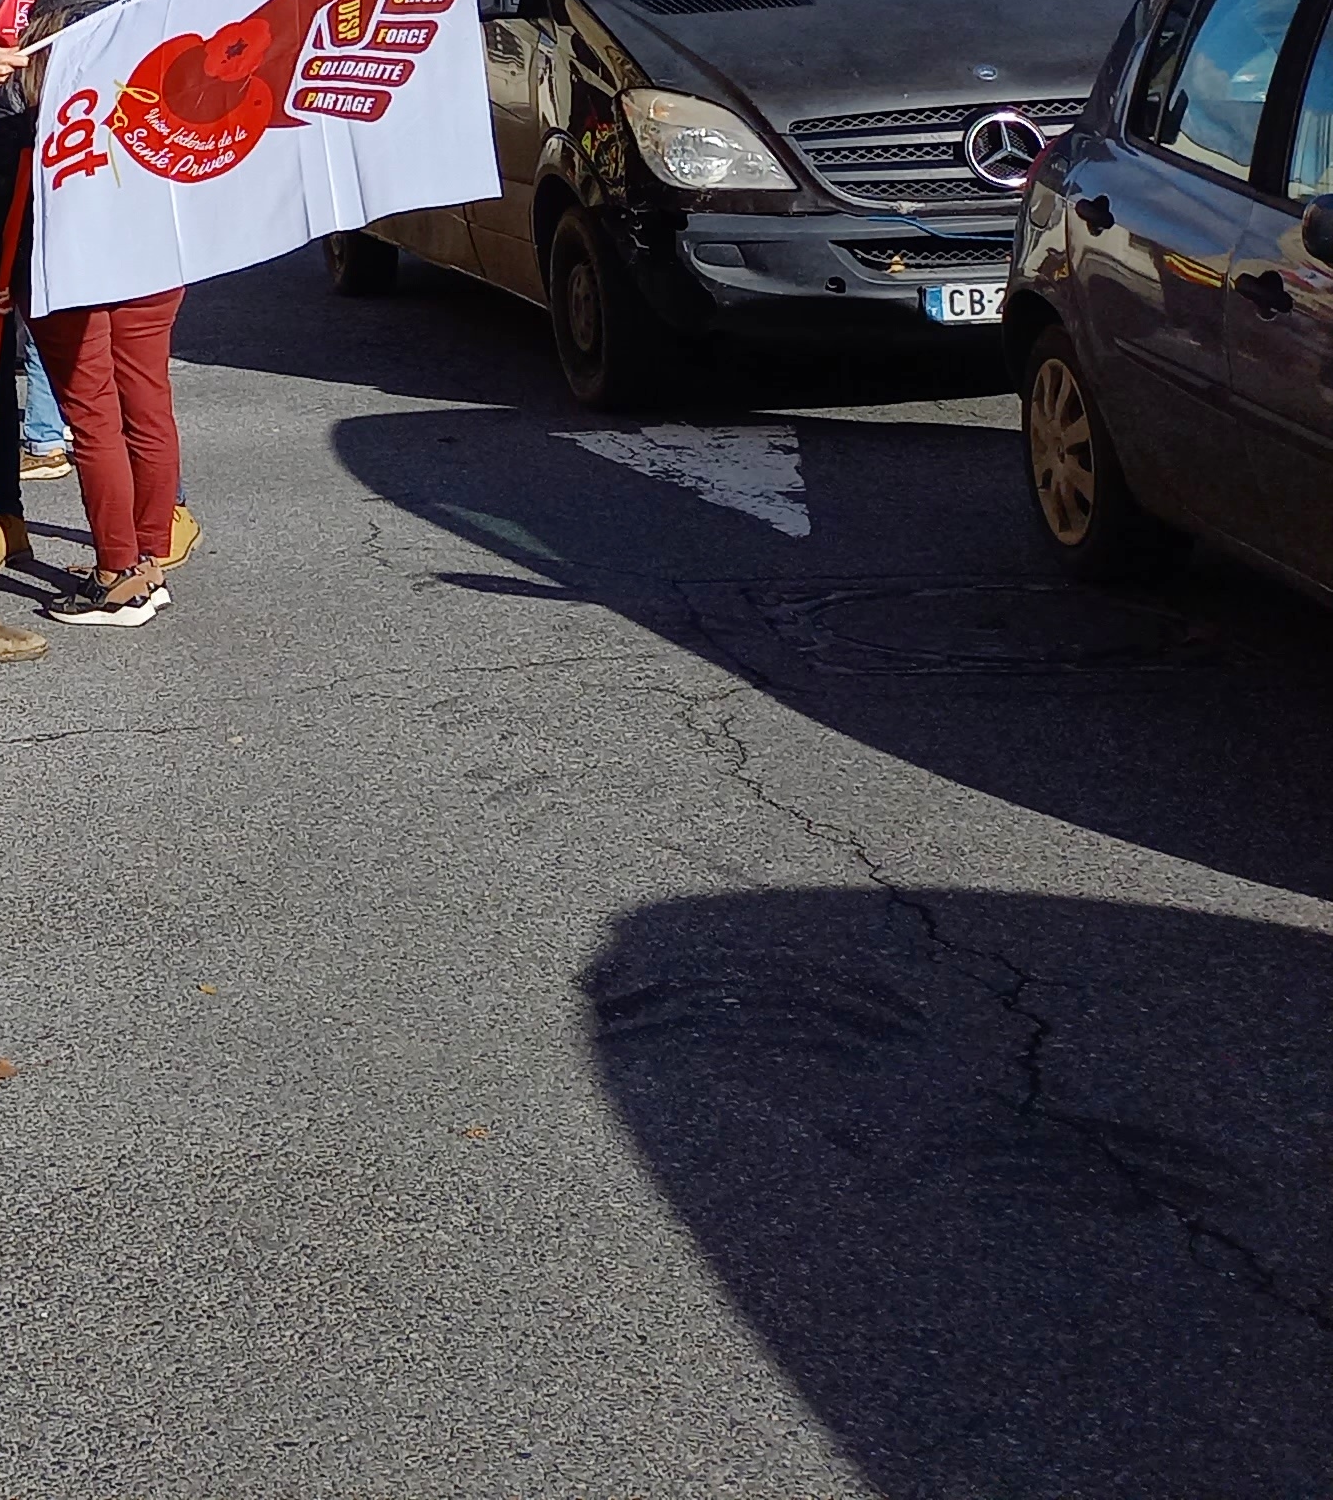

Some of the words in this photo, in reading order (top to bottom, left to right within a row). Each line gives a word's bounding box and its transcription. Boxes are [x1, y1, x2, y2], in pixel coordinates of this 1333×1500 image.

[338, 0, 361, 40] UFSP
[376, 28, 429, 45] FORCE
[309, 61, 404, 81] SOLIDARITÉ
[303, 92, 375, 114] PARTAGE
[41, 88, 109, 191] cgt
[144, 107, 171, 136] Union
[164, 127, 215, 150] fédérale
[217, 129, 233, 148] de
[234, 125, 248, 142] la
[124, 128, 175, 169] Santé
[170, 148, 236, 177] Privée
